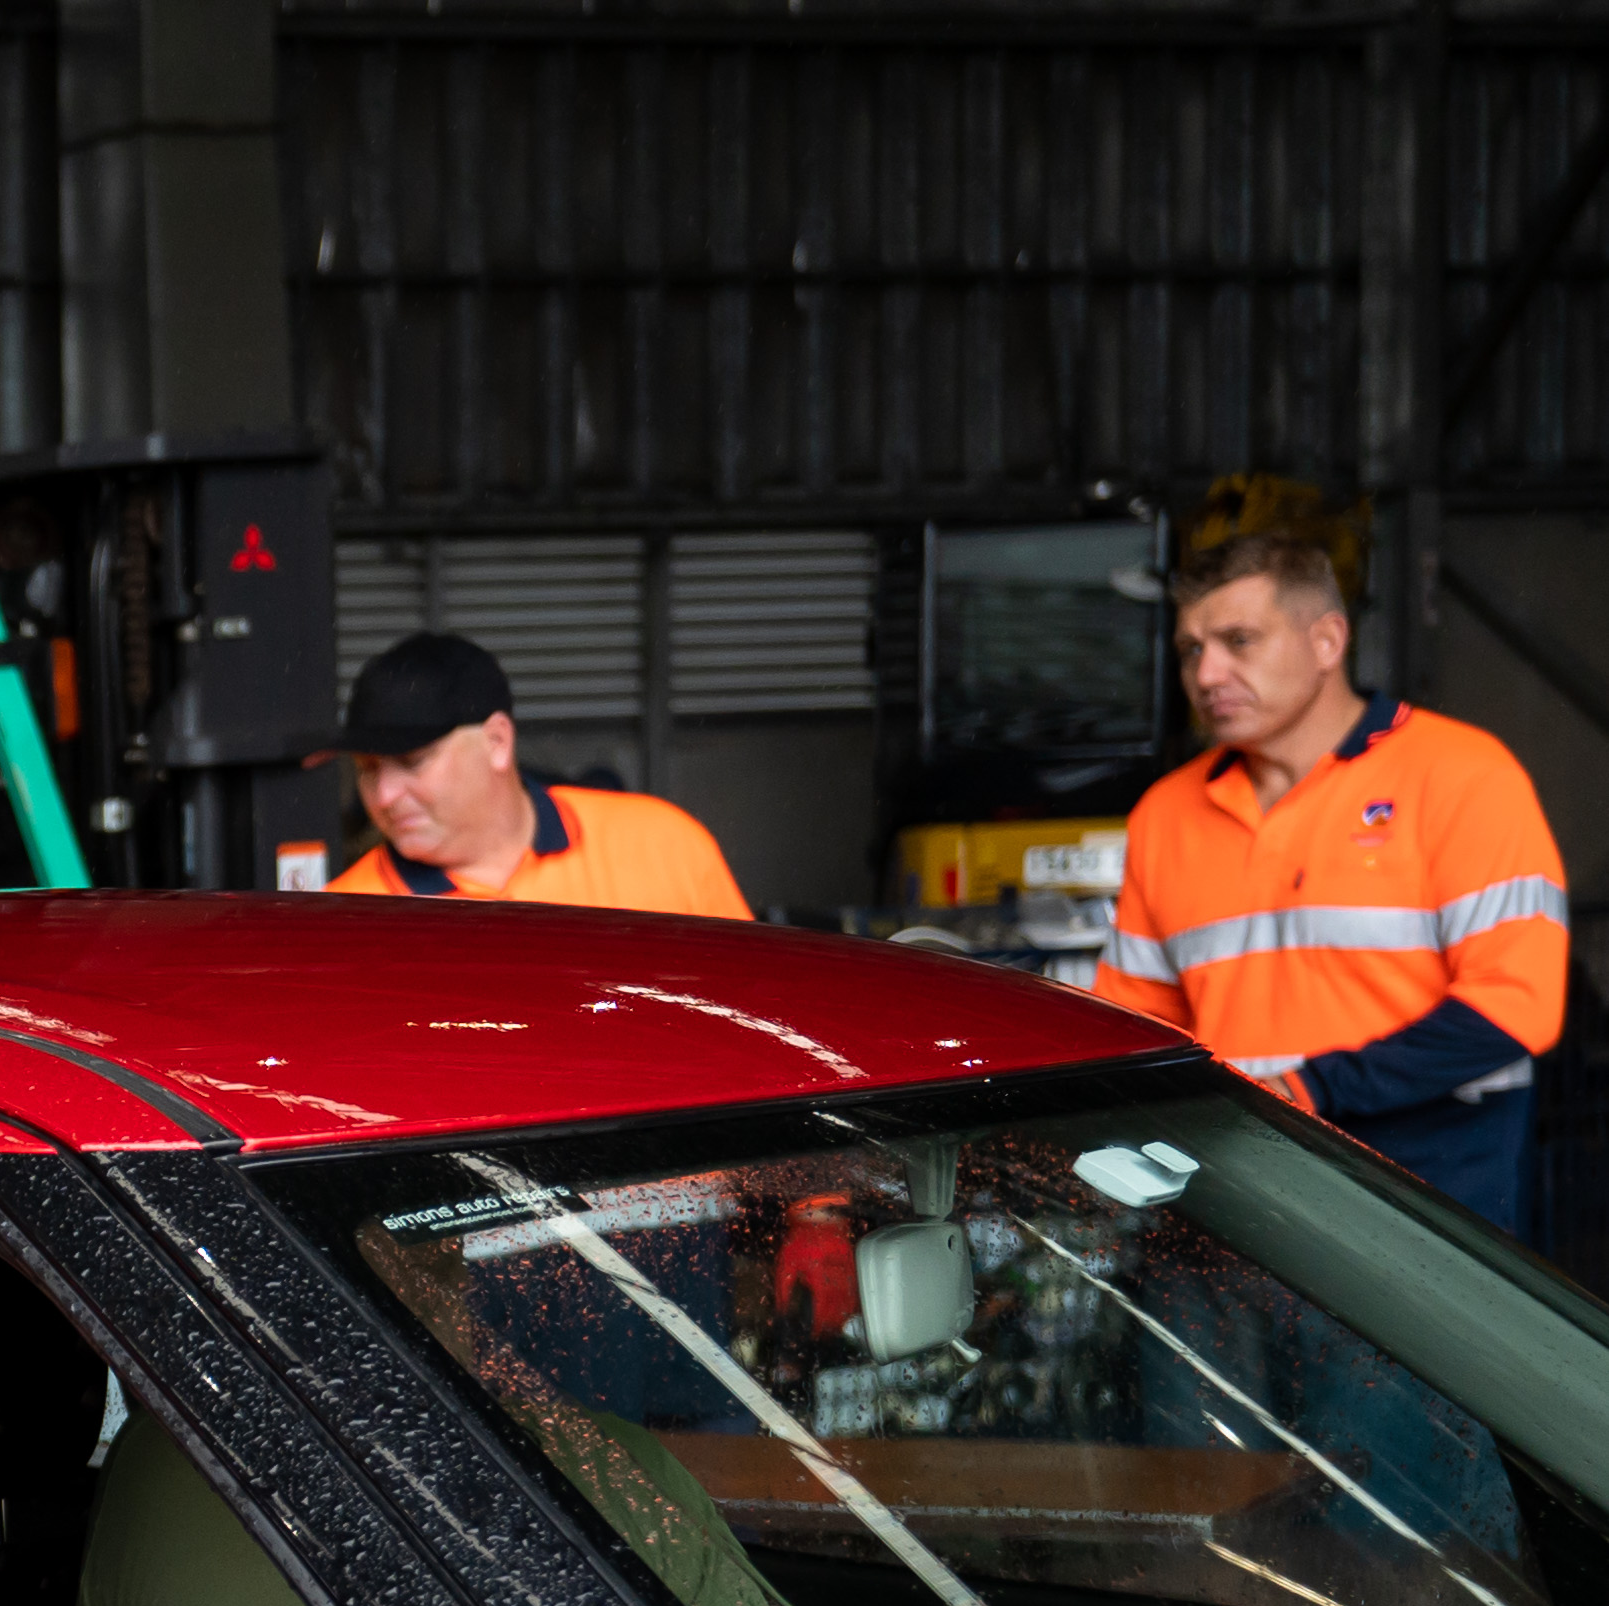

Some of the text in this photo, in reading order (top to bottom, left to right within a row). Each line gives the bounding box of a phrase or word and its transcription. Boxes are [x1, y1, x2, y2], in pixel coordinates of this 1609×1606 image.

[383, 1206, 454, 1230] simons
[455, 1198, 500, 1214] auto
[502, 1185, 571, 1206] repairs
